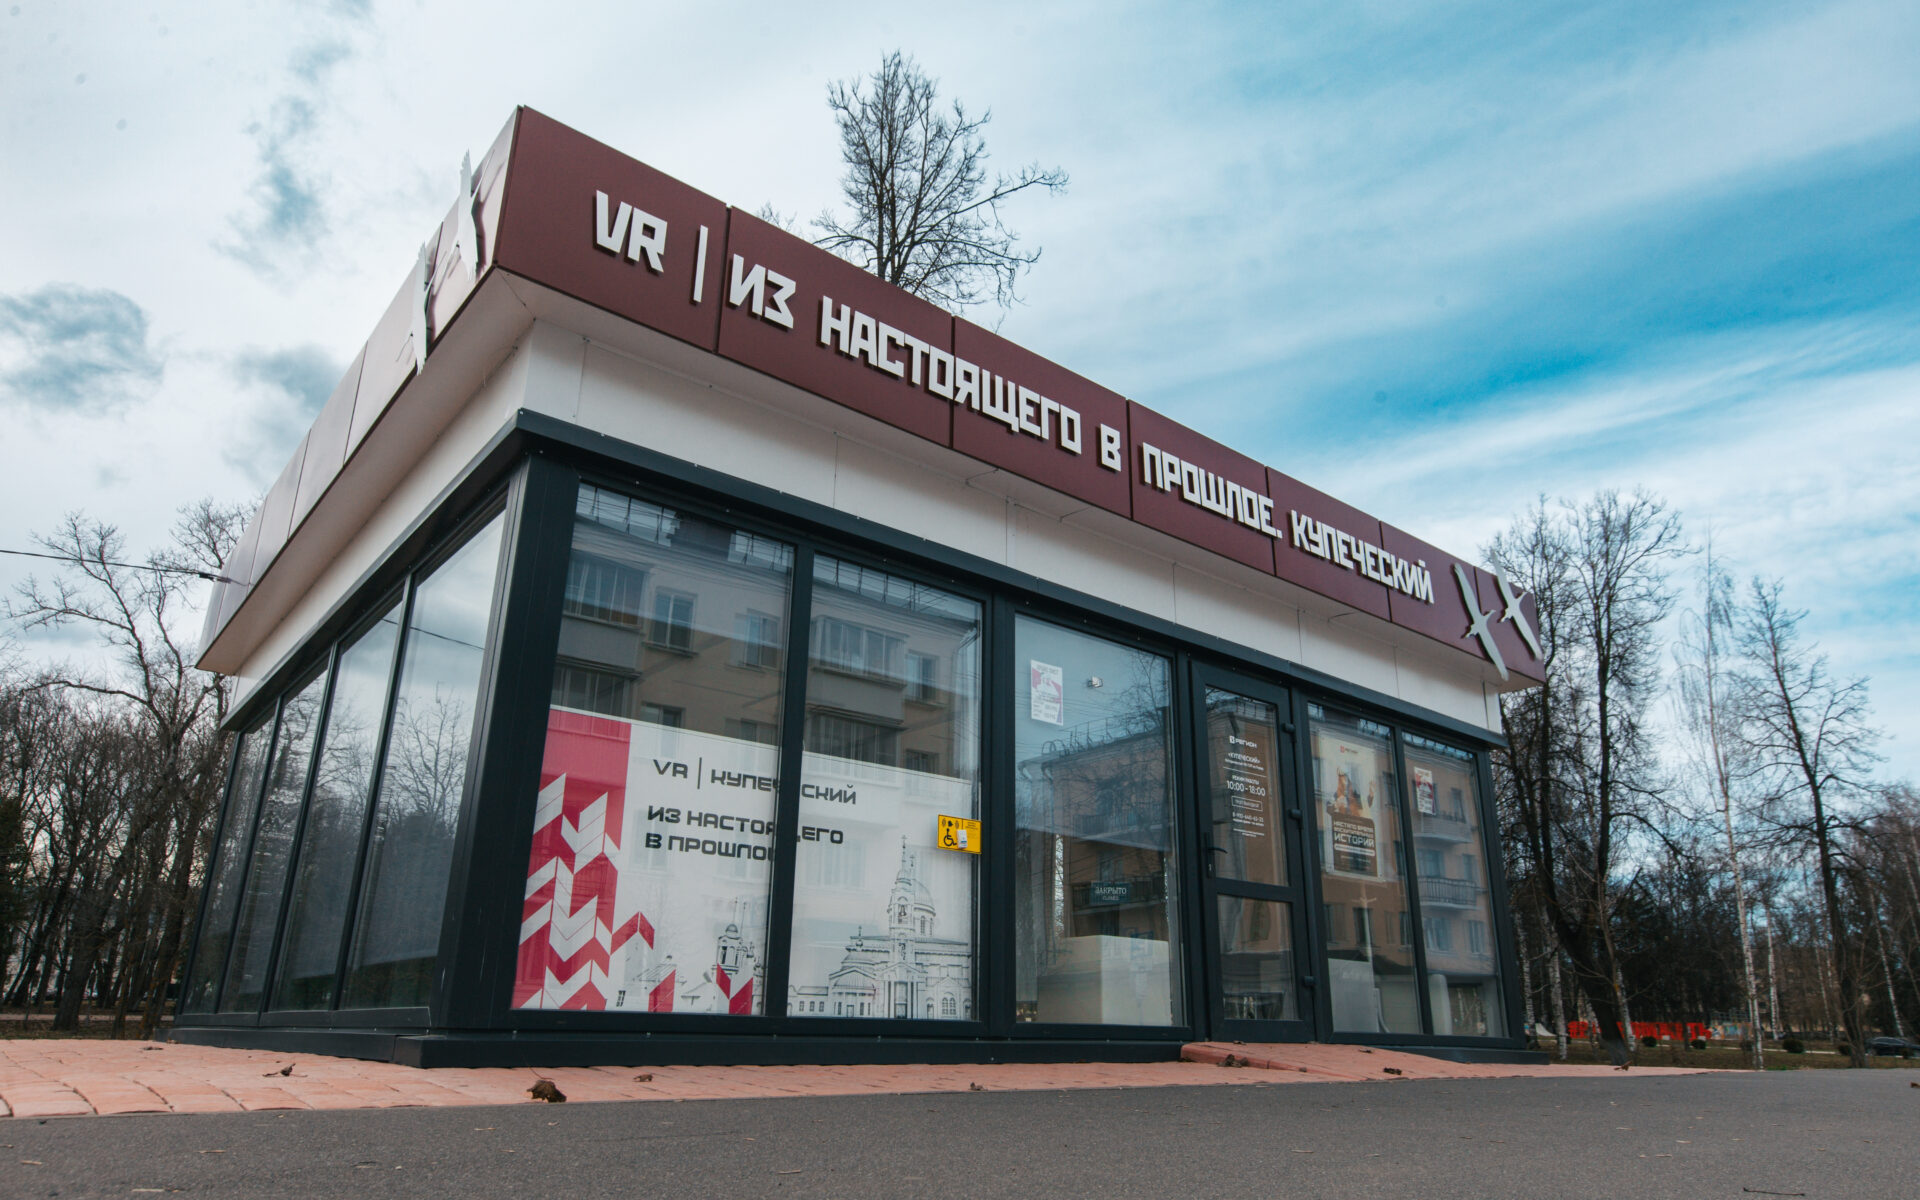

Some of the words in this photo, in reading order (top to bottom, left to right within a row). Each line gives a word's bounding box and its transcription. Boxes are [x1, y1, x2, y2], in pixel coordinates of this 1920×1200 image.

[595, 189, 668, 274] VR
[729, 253, 797, 330] ИЗ
[820, 295, 1083, 455] НАСТОЯЩЕГО
[1100, 423, 1122, 472] В
[1142, 442, 1283, 540] ПРОШЛОЕ.
[1290, 509, 1435, 605] КУПЕЧЕСКИЙ
[653, 759, 689, 779] VR
[1226, 780, 1244, 792] 10:00
[648, 805, 681, 824] ИЗ
[645, 833, 663, 849] В
[1095, 887, 1127, 895] ЗАКРЫТО
